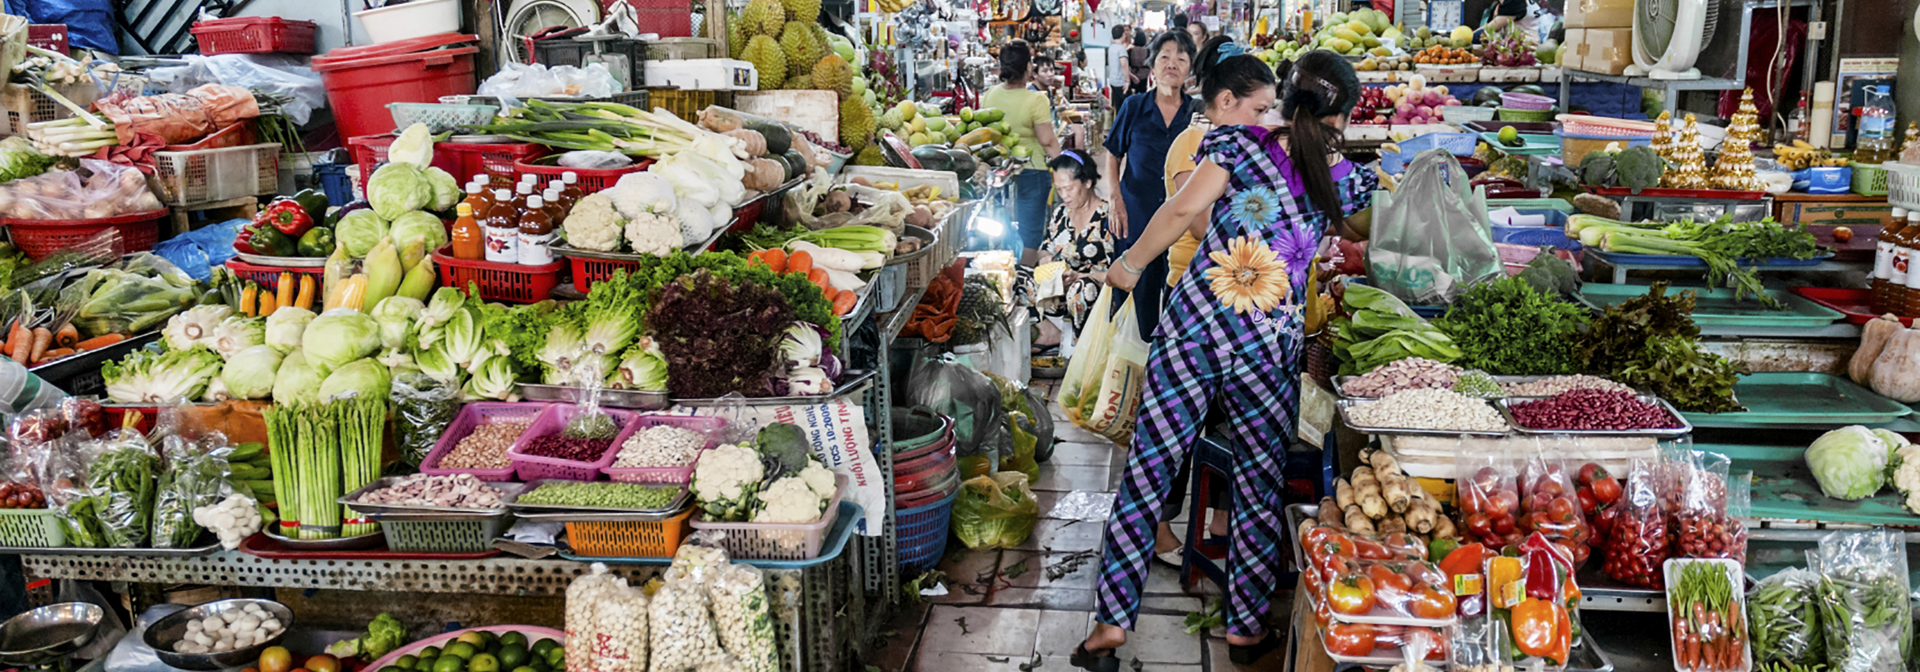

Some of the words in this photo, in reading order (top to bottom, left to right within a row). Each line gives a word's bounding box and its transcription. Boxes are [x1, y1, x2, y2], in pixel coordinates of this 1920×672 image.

[774, 405, 796, 425] IỆU
[830, 445, 842, 467] TCCS
[848, 459, 868, 487] KHỐI
